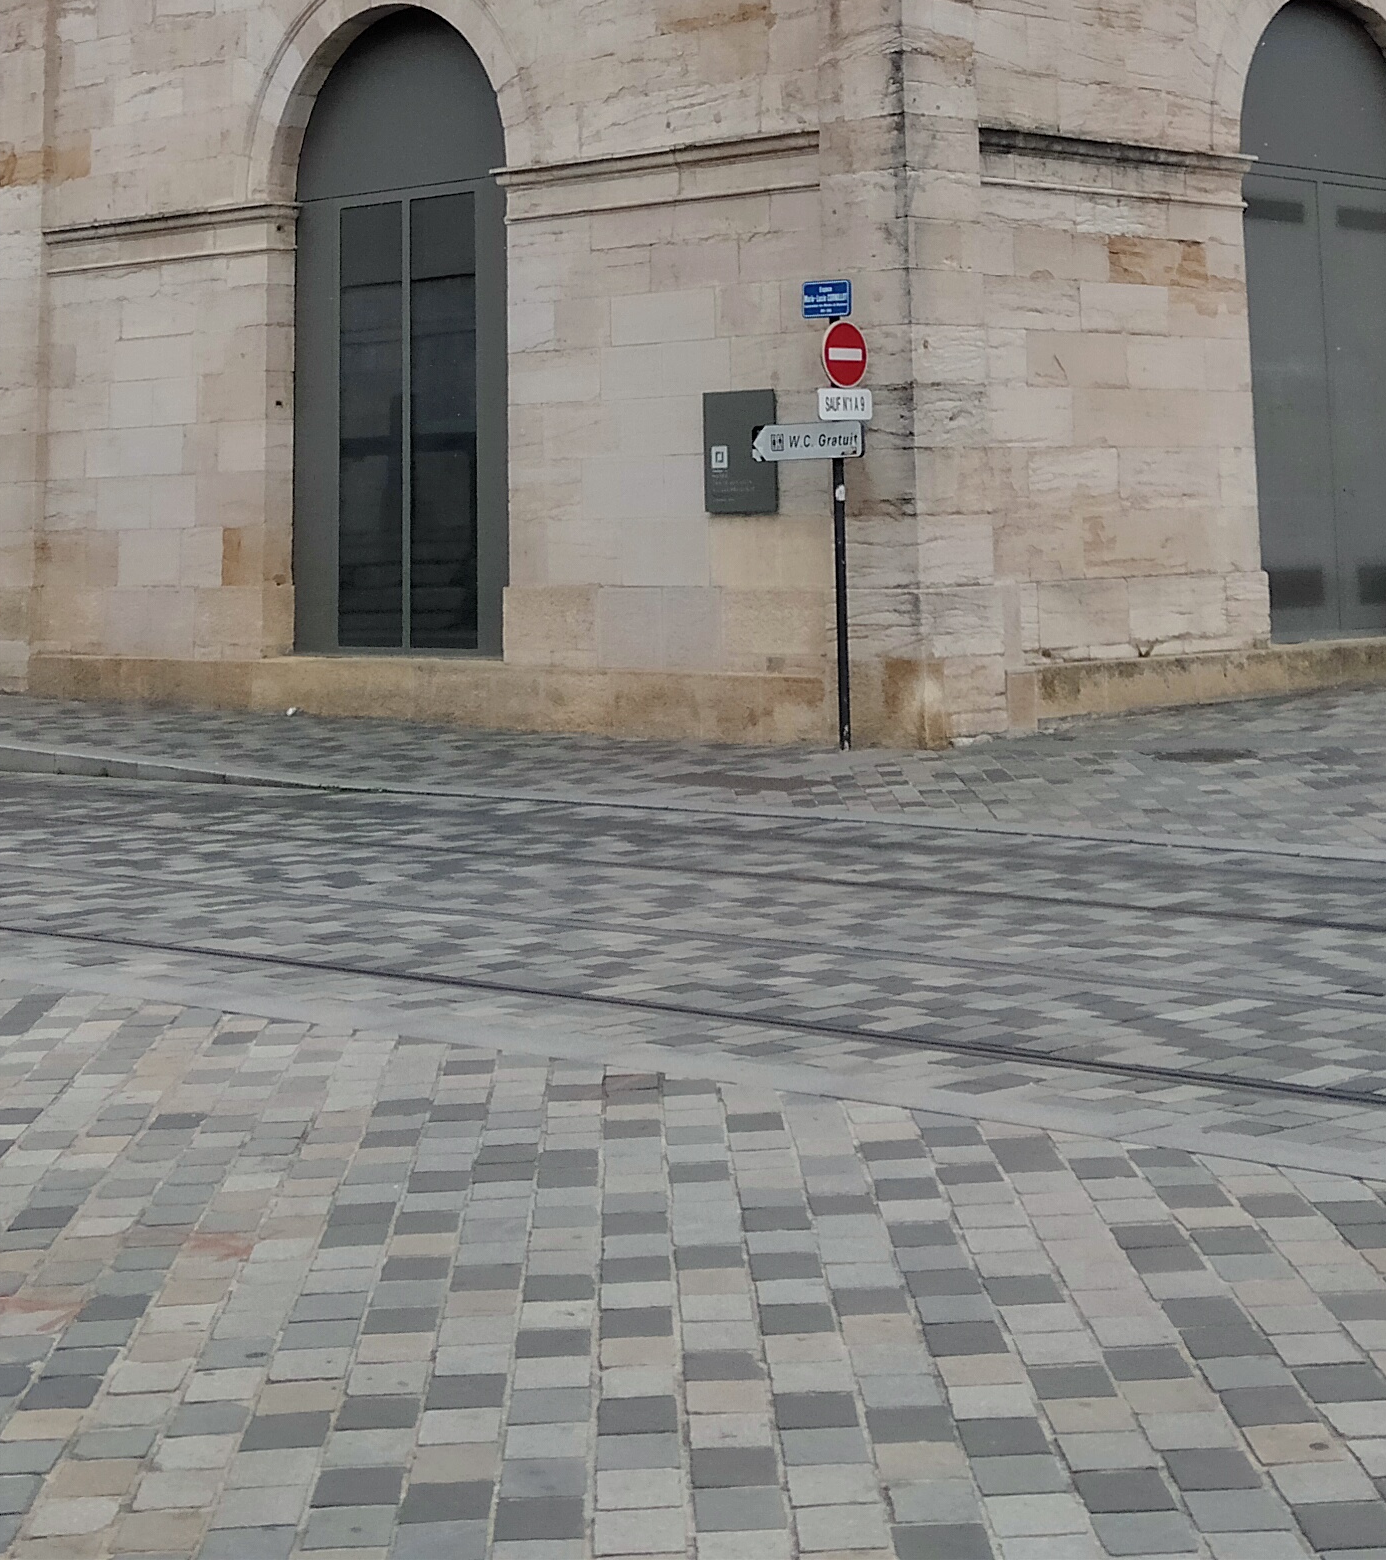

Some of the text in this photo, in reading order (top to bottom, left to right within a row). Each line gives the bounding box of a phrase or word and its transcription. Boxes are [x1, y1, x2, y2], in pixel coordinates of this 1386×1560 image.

[825, 396, 841, 412] SAUF
[860, 396, 865, 411] 9
[789, 432, 858, 448] W.C. Gratuit
